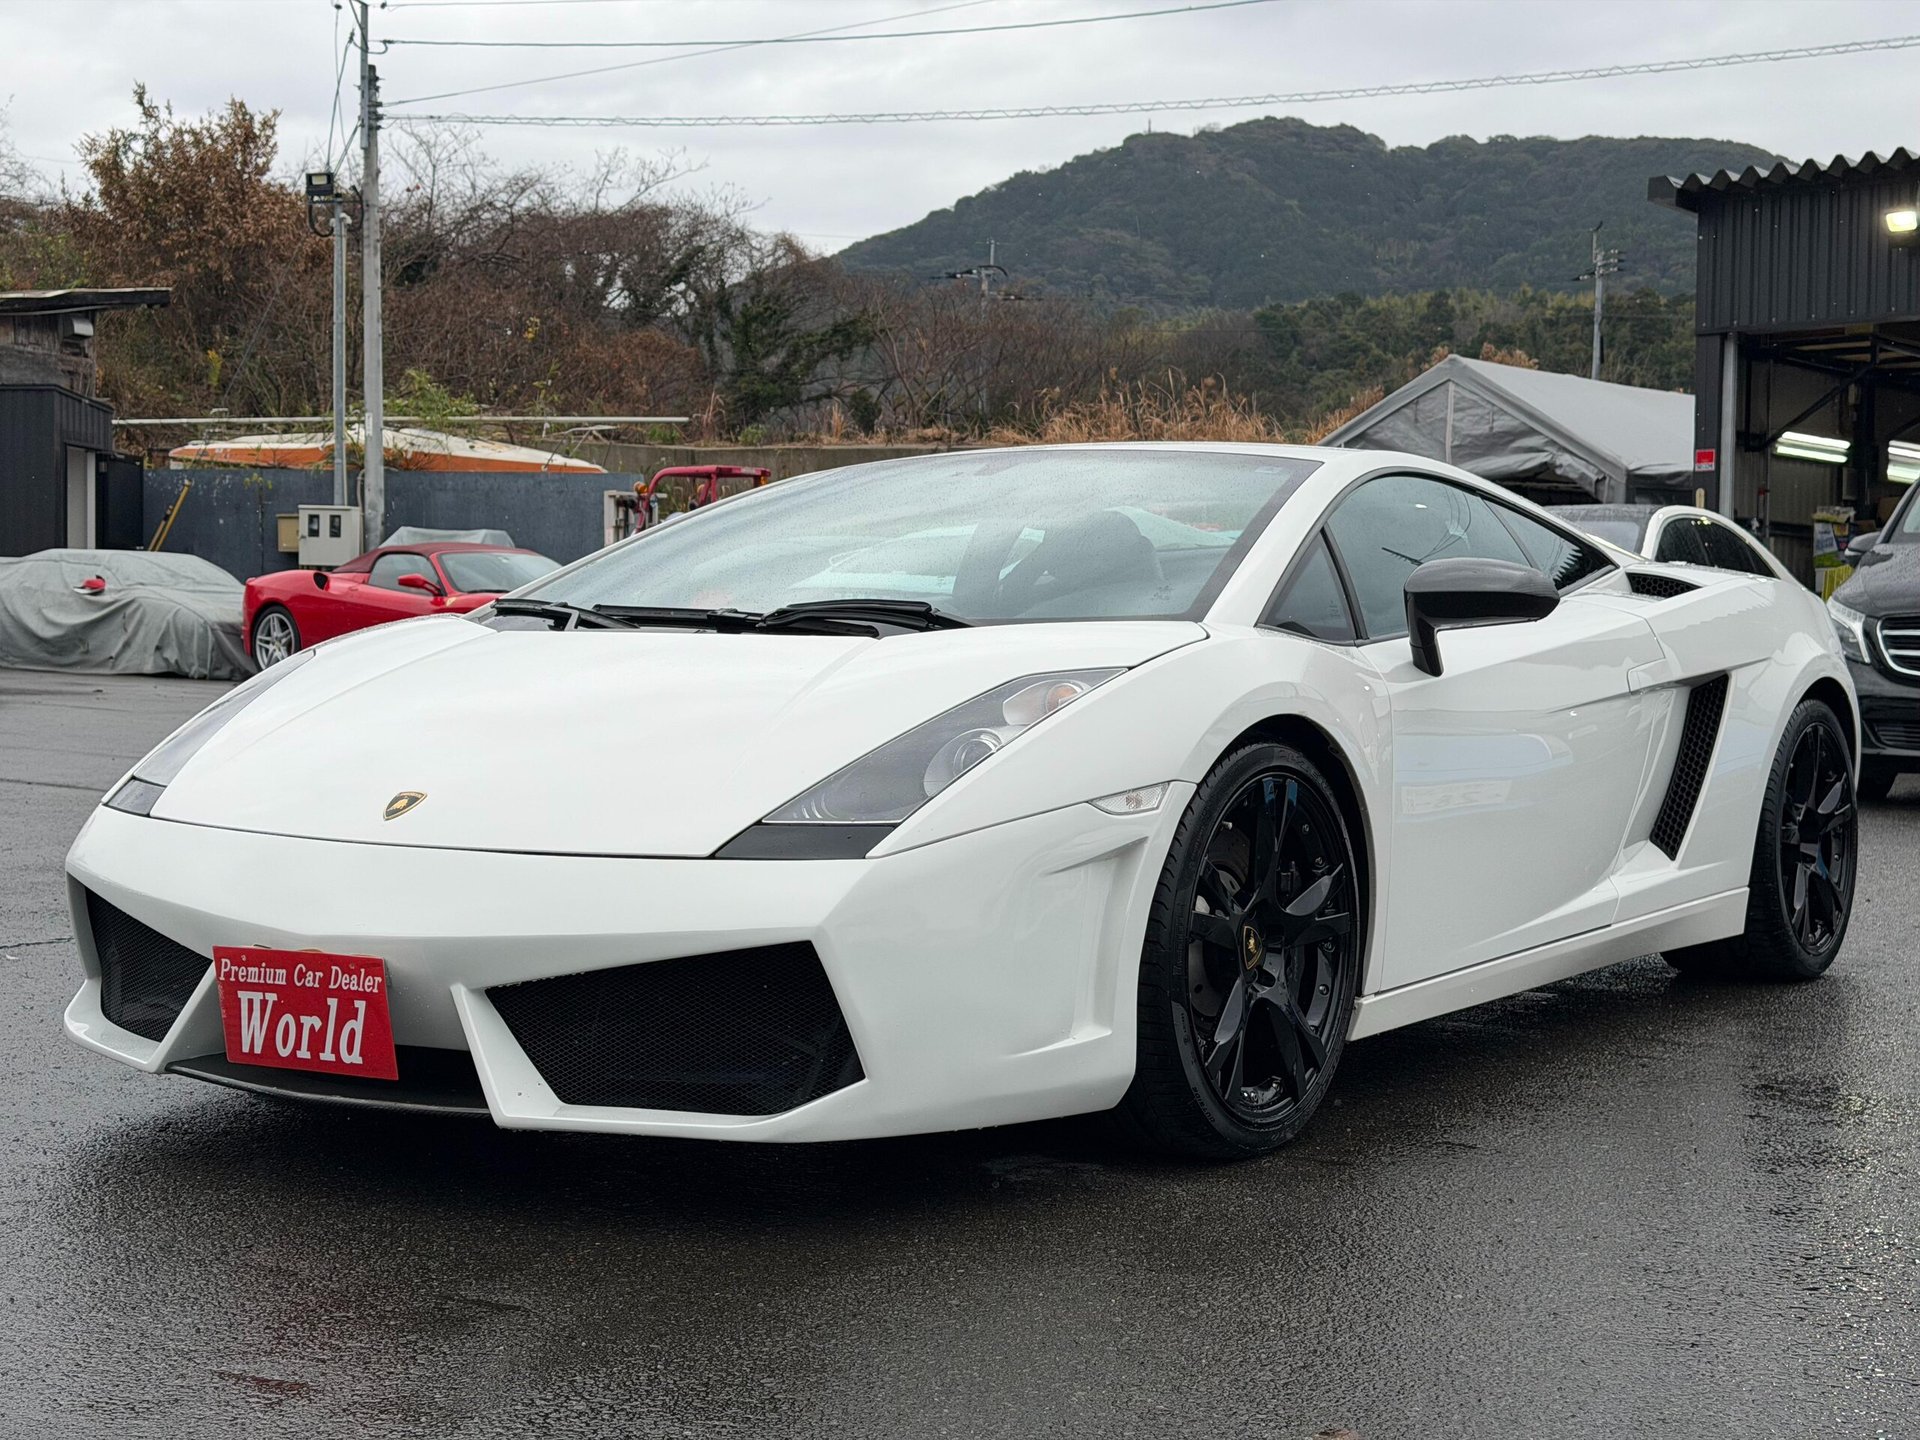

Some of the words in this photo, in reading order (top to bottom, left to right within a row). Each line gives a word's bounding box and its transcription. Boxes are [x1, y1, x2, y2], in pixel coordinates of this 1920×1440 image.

[219, 958, 287, 985] Premium
[294, 964, 323, 988] Car
[329, 966, 382, 993] Dealer
[237, 990, 366, 1065] World
